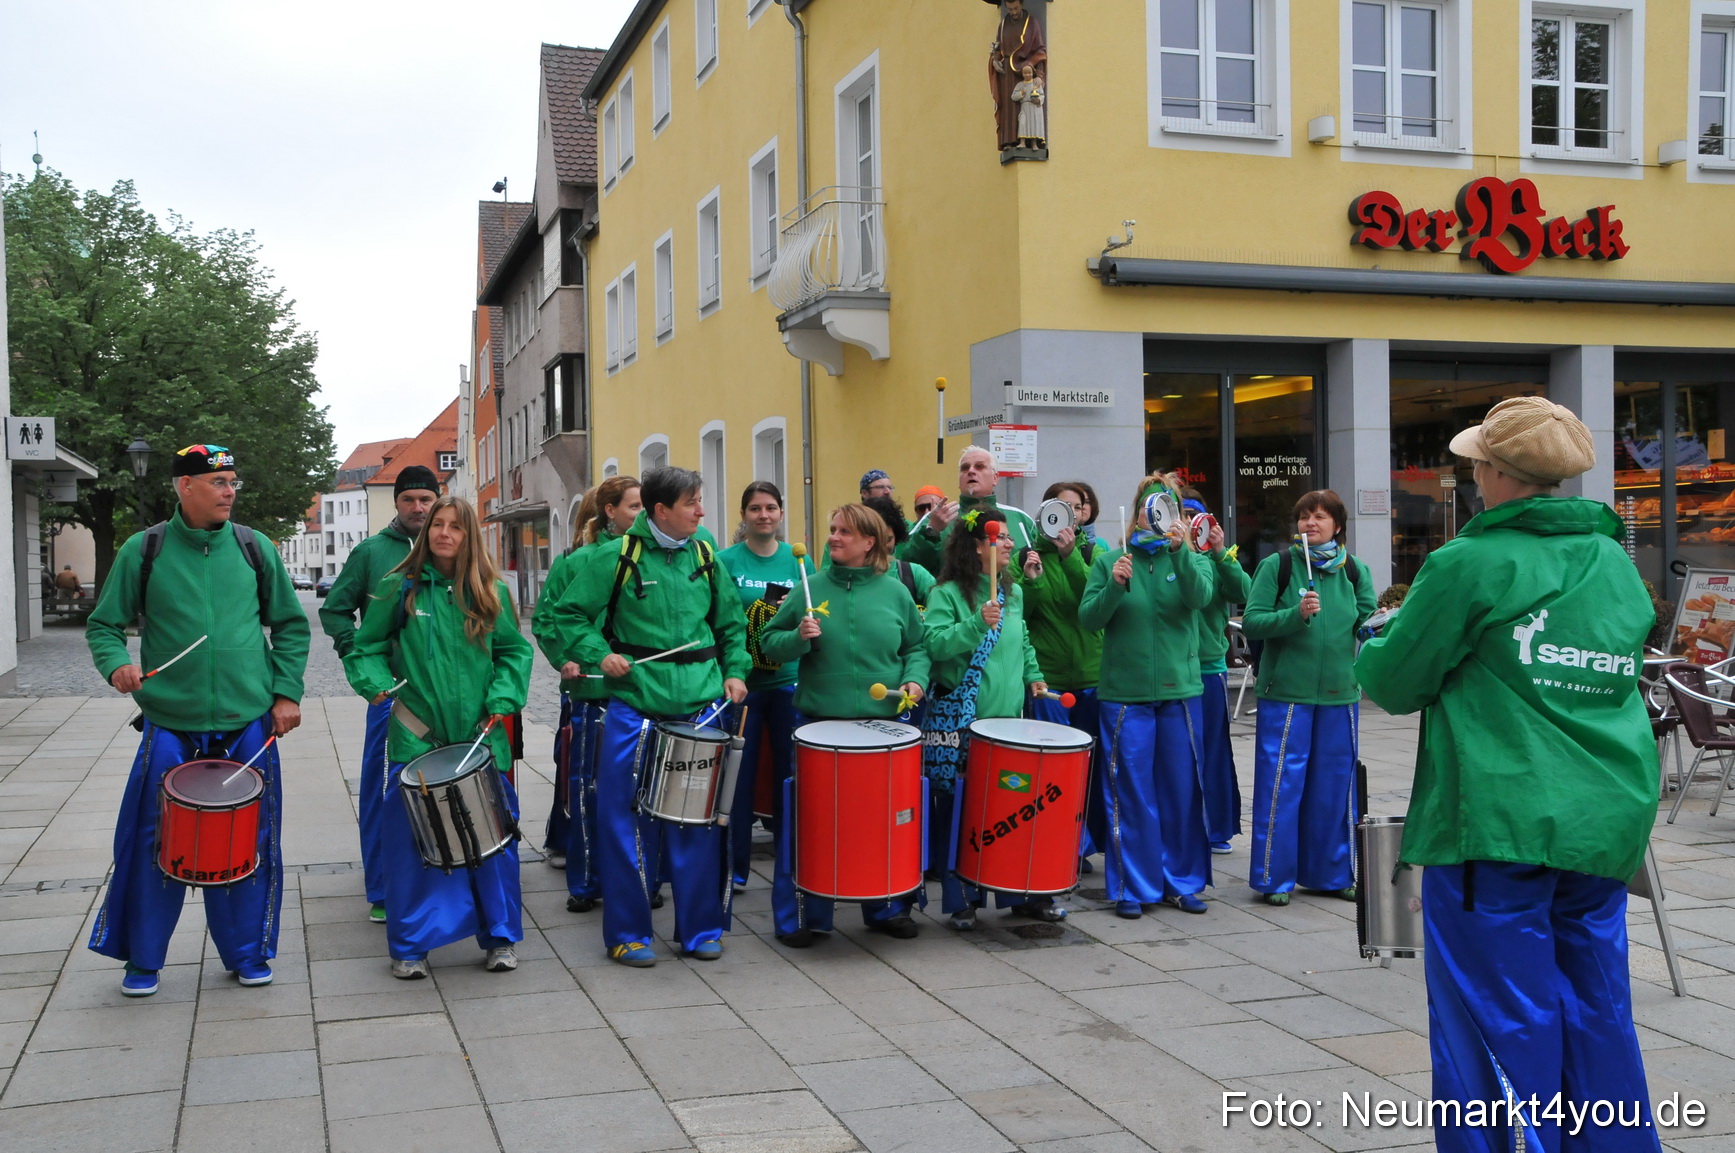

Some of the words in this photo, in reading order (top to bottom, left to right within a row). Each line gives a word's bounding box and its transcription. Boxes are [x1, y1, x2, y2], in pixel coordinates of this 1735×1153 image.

[1350, 190, 1458, 251] Der
[1460, 176, 1630, 273] Beck
[1052, 390, 1109, 403] Marktstraße
[948, 413, 1004, 432] Grünbaumwirtsgasse
[25, 449, 39, 457] WC
[1243, 455, 1260, 464] Sonn
[1264, 455, 1277, 464] und
[1278, 455, 1307, 465] Feiertage
[1239, 467, 1254, 475] von
[1257, 466, 1277, 476] 8.00
[1286, 466, 1312, 476] 18.00
[1262, 478, 1289, 489] geöffnet
[745, 578, 794, 588] sarrá
[1712, 583, 1720, 591] zu
[1722, 583, 1735, 593] Bec
[1537, 643, 1635, 676] sarará
[1532, 677, 1614, 695] www.sarara.de
[981, 782, 1062, 847] sarará
[182, 859, 251, 881] sarará
